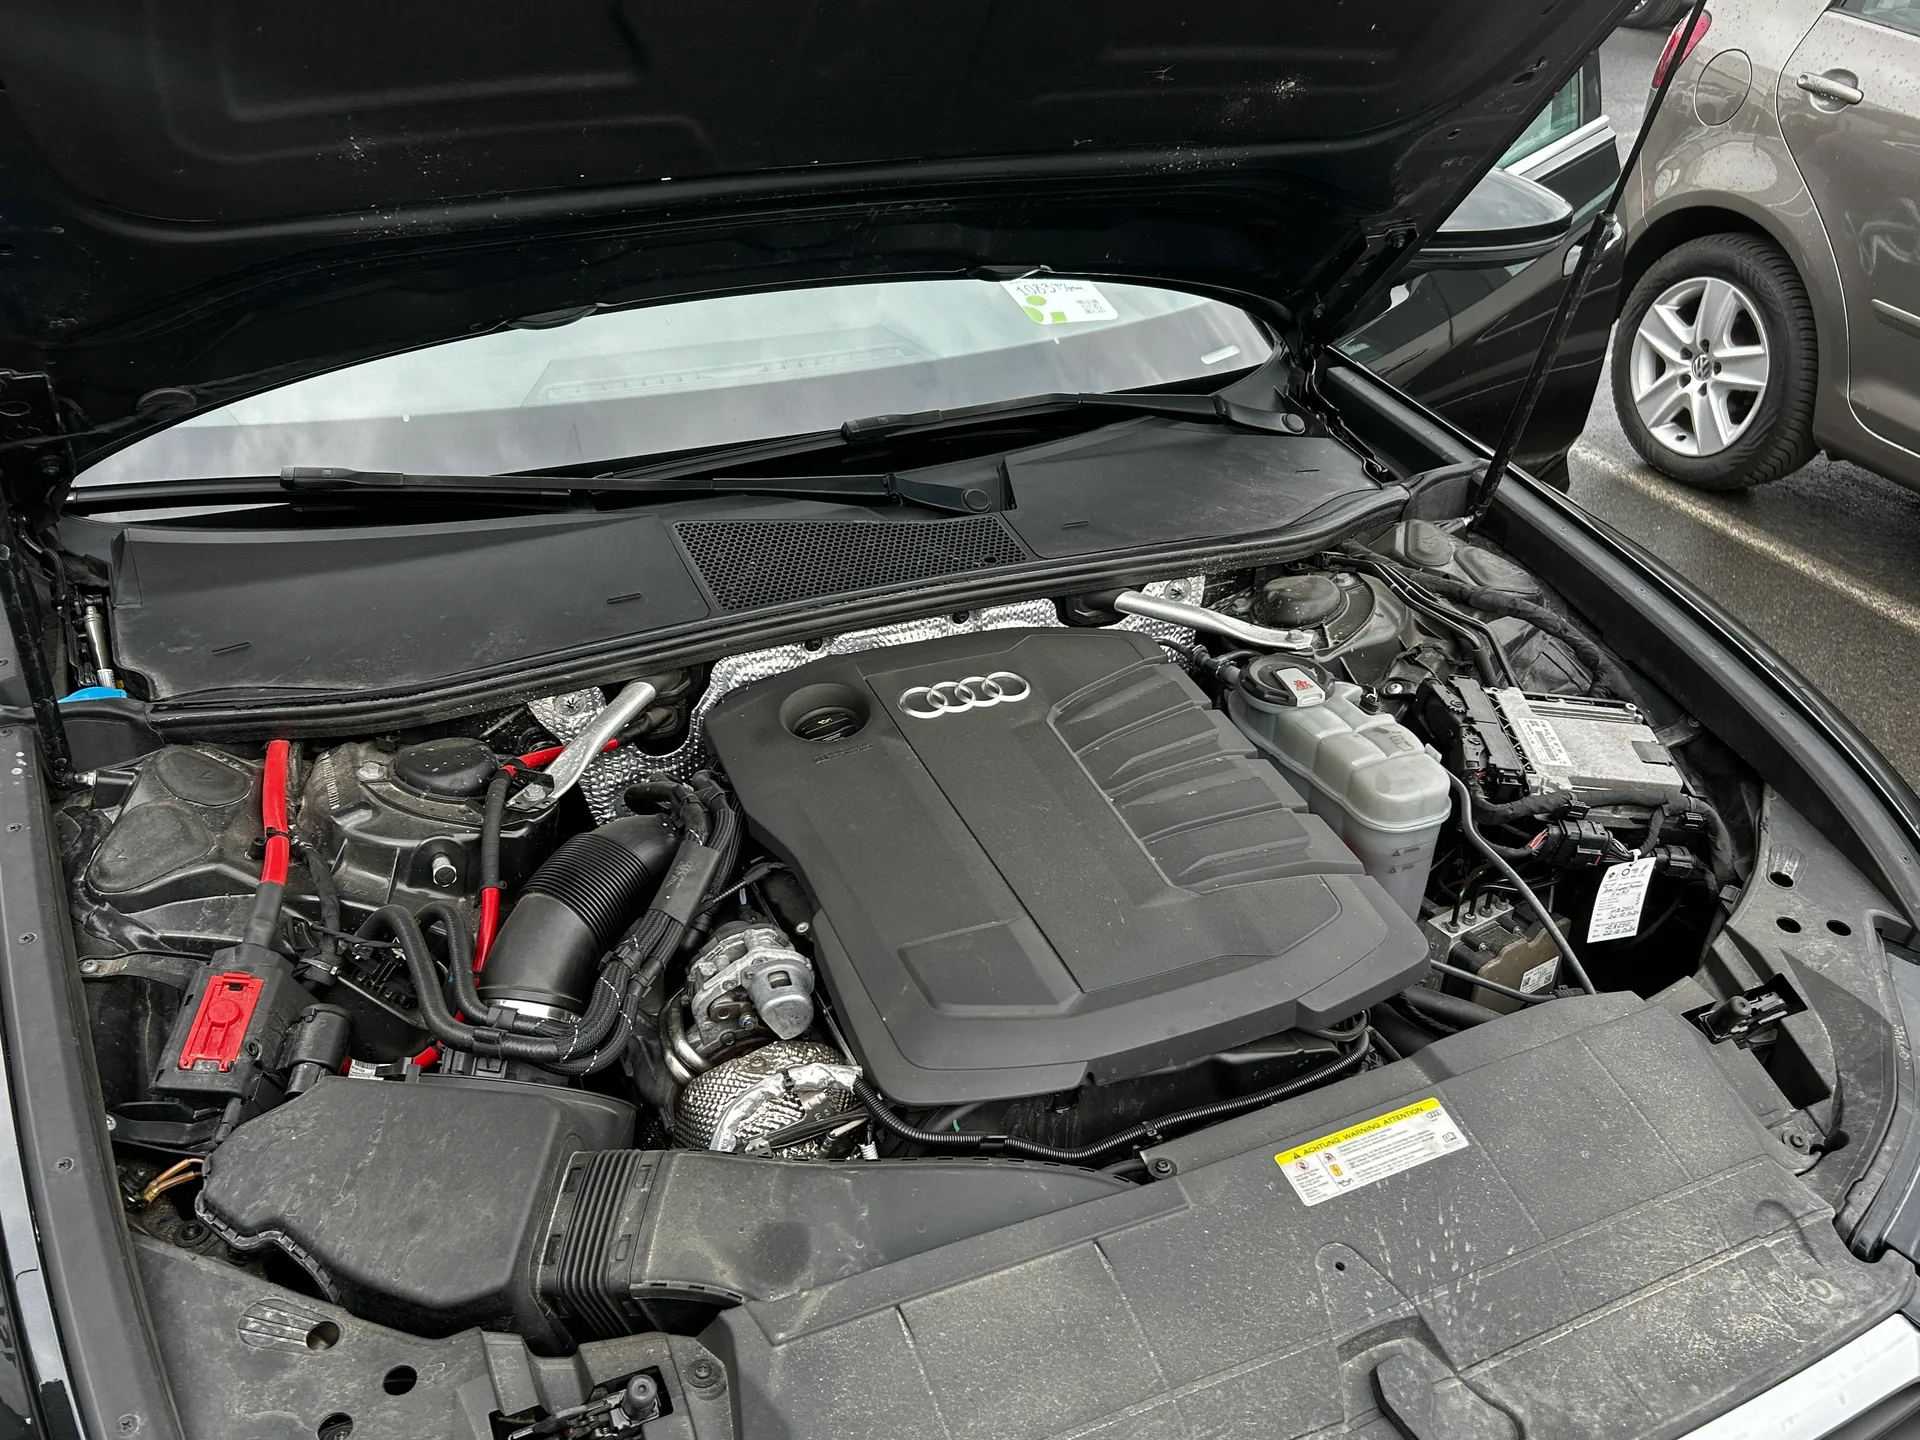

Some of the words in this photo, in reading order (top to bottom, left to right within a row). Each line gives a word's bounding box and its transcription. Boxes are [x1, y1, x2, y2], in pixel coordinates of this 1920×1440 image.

[1303, 1137, 1341, 1155] ACHTUNG
[1342, 1122, 1381, 1140] WARNING
[1383, 1106, 1424, 1126] ATTENTION
